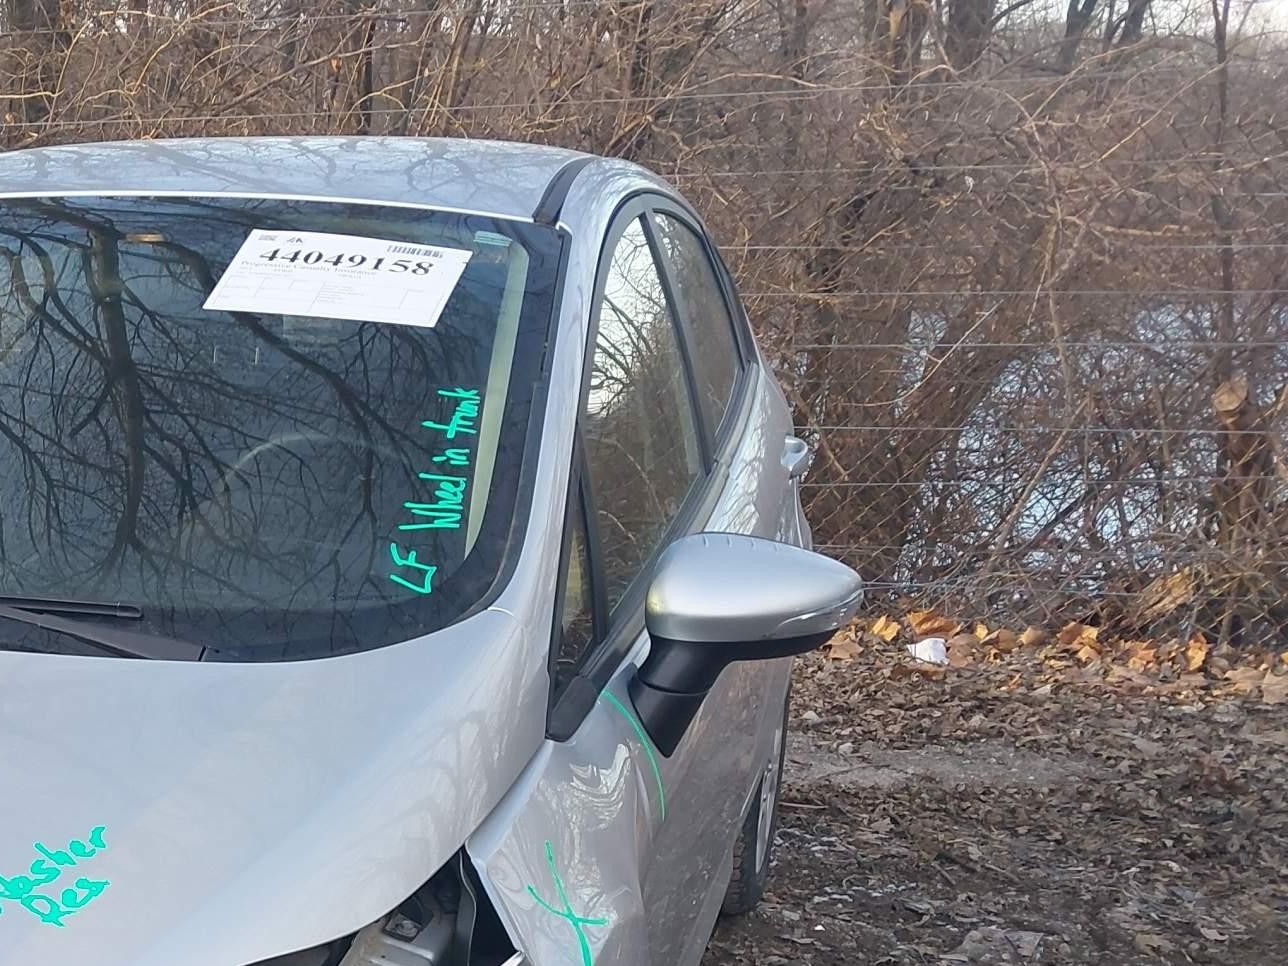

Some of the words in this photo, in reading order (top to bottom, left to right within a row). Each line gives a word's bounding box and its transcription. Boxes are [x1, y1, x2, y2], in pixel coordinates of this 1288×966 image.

[259, 247, 435, 276] 44049158
[432, 448, 471, 465] in
[398, 472, 467, 530] Wheel
[390, 542, 437, 594] LF
